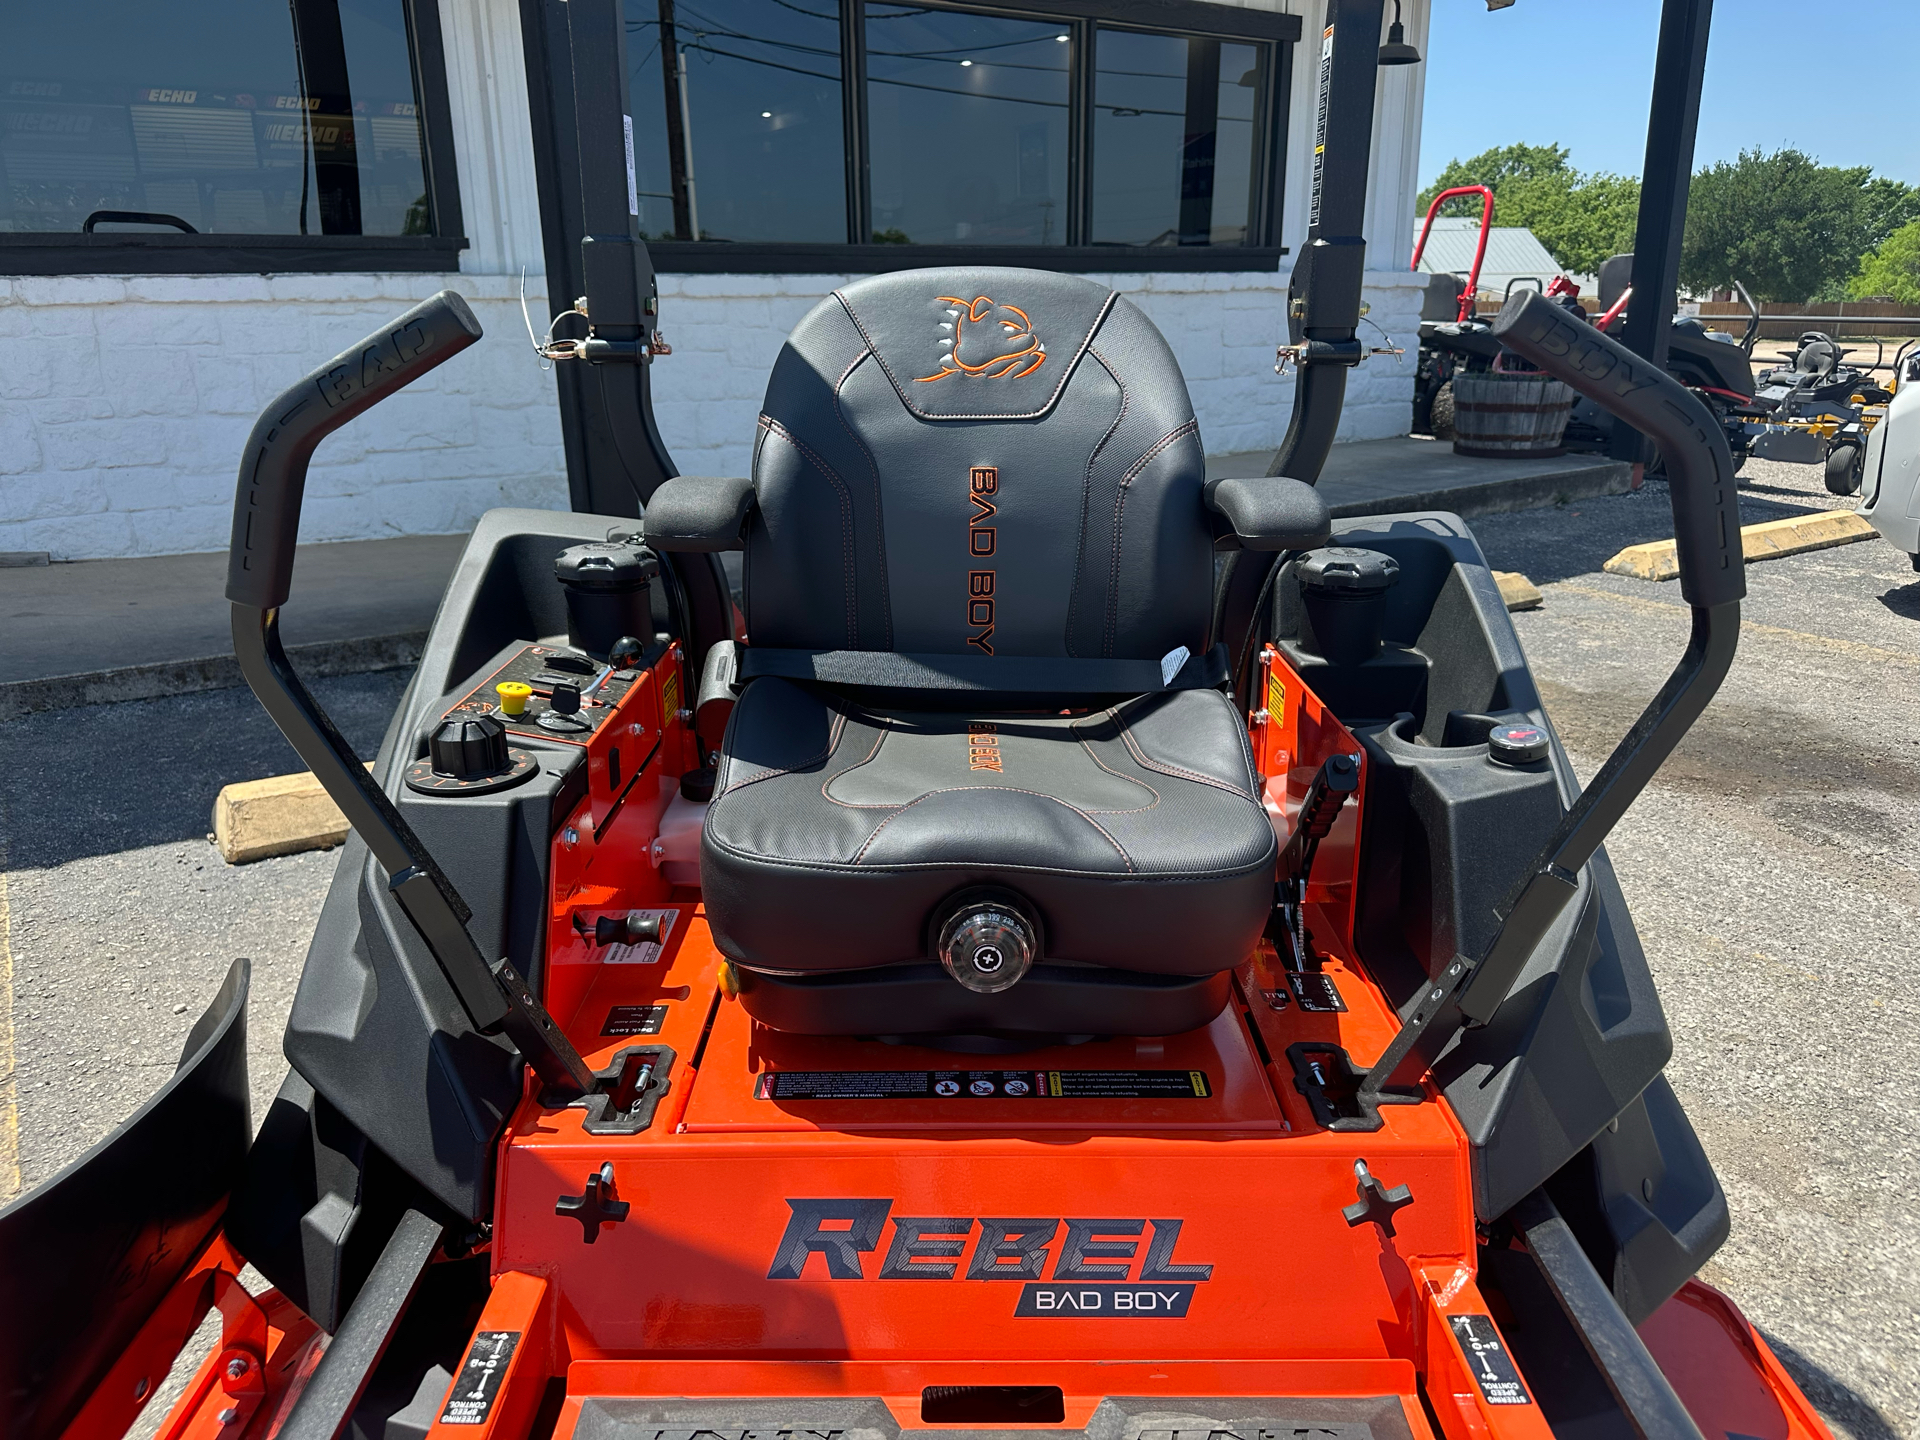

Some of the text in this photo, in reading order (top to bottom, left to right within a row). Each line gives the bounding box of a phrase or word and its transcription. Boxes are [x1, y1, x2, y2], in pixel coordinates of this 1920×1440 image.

[149, 89, 197, 104] ECHO
[276, 96, 321, 111] ECHO
[280, 125, 340, 143] ECHO
[316, 317, 434, 408] BAD
[1529, 314, 1659, 398] BOY
[967, 466, 998, 657] BAD BOY
[969, 747, 1004, 774] BOY
[767, 1198, 1214, 1281] REBEL
[1036, 1291, 1180, 1310] BAD BOY
[1481, 1382, 1519, 1390] CONTROL
[449, 1401, 487, 1409] CONTROL
[1487, 1395, 1527, 1404] STEERING
[440, 1414, 482, 1423] STEERING
